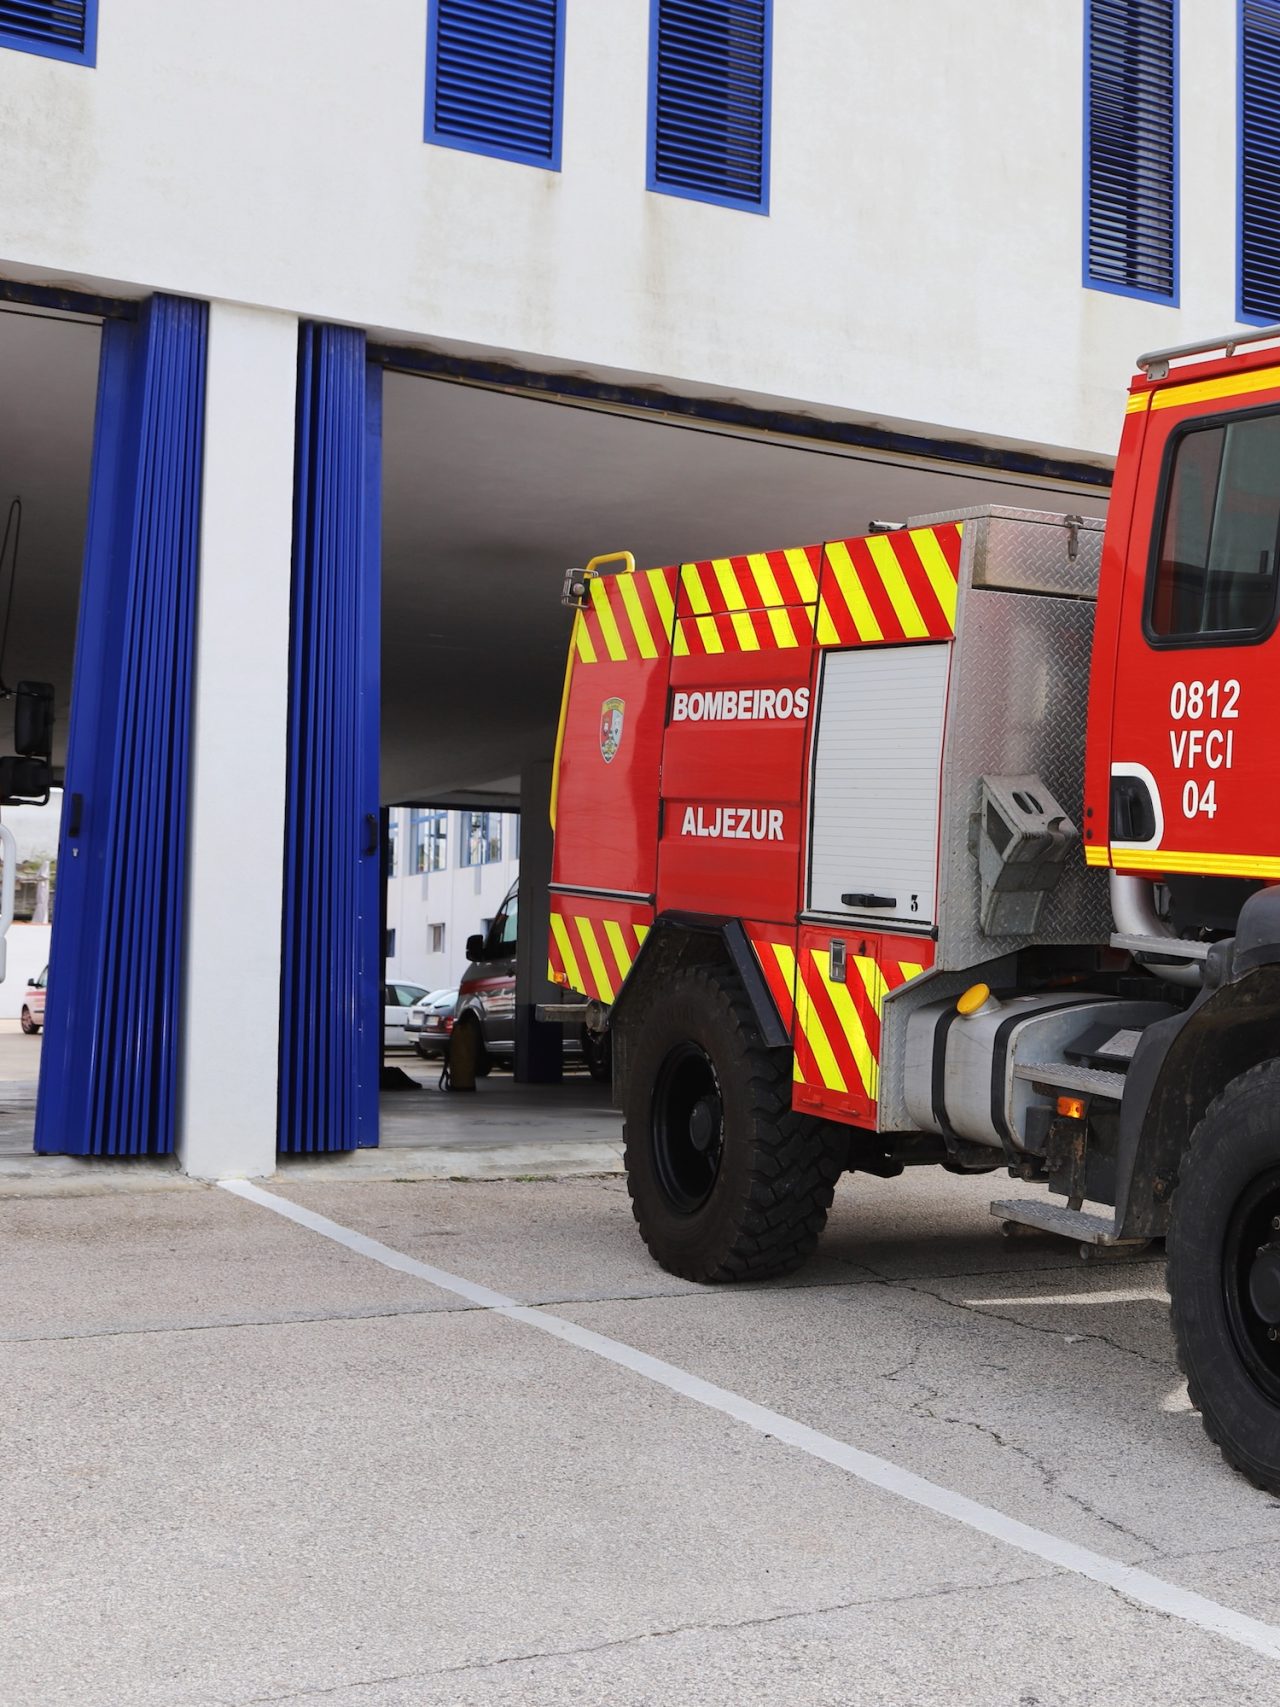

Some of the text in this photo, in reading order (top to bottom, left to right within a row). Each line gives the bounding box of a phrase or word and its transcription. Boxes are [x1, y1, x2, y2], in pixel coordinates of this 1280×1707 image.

[673, 687, 810, 721] BOMBEIROS
[1170, 679, 1240, 720] 0812
[1169, 729, 1233, 769] VFCI
[1182, 779, 1217, 819] 04
[681, 807, 784, 840] ALJEZUR
[911, 894, 919, 912] 3
